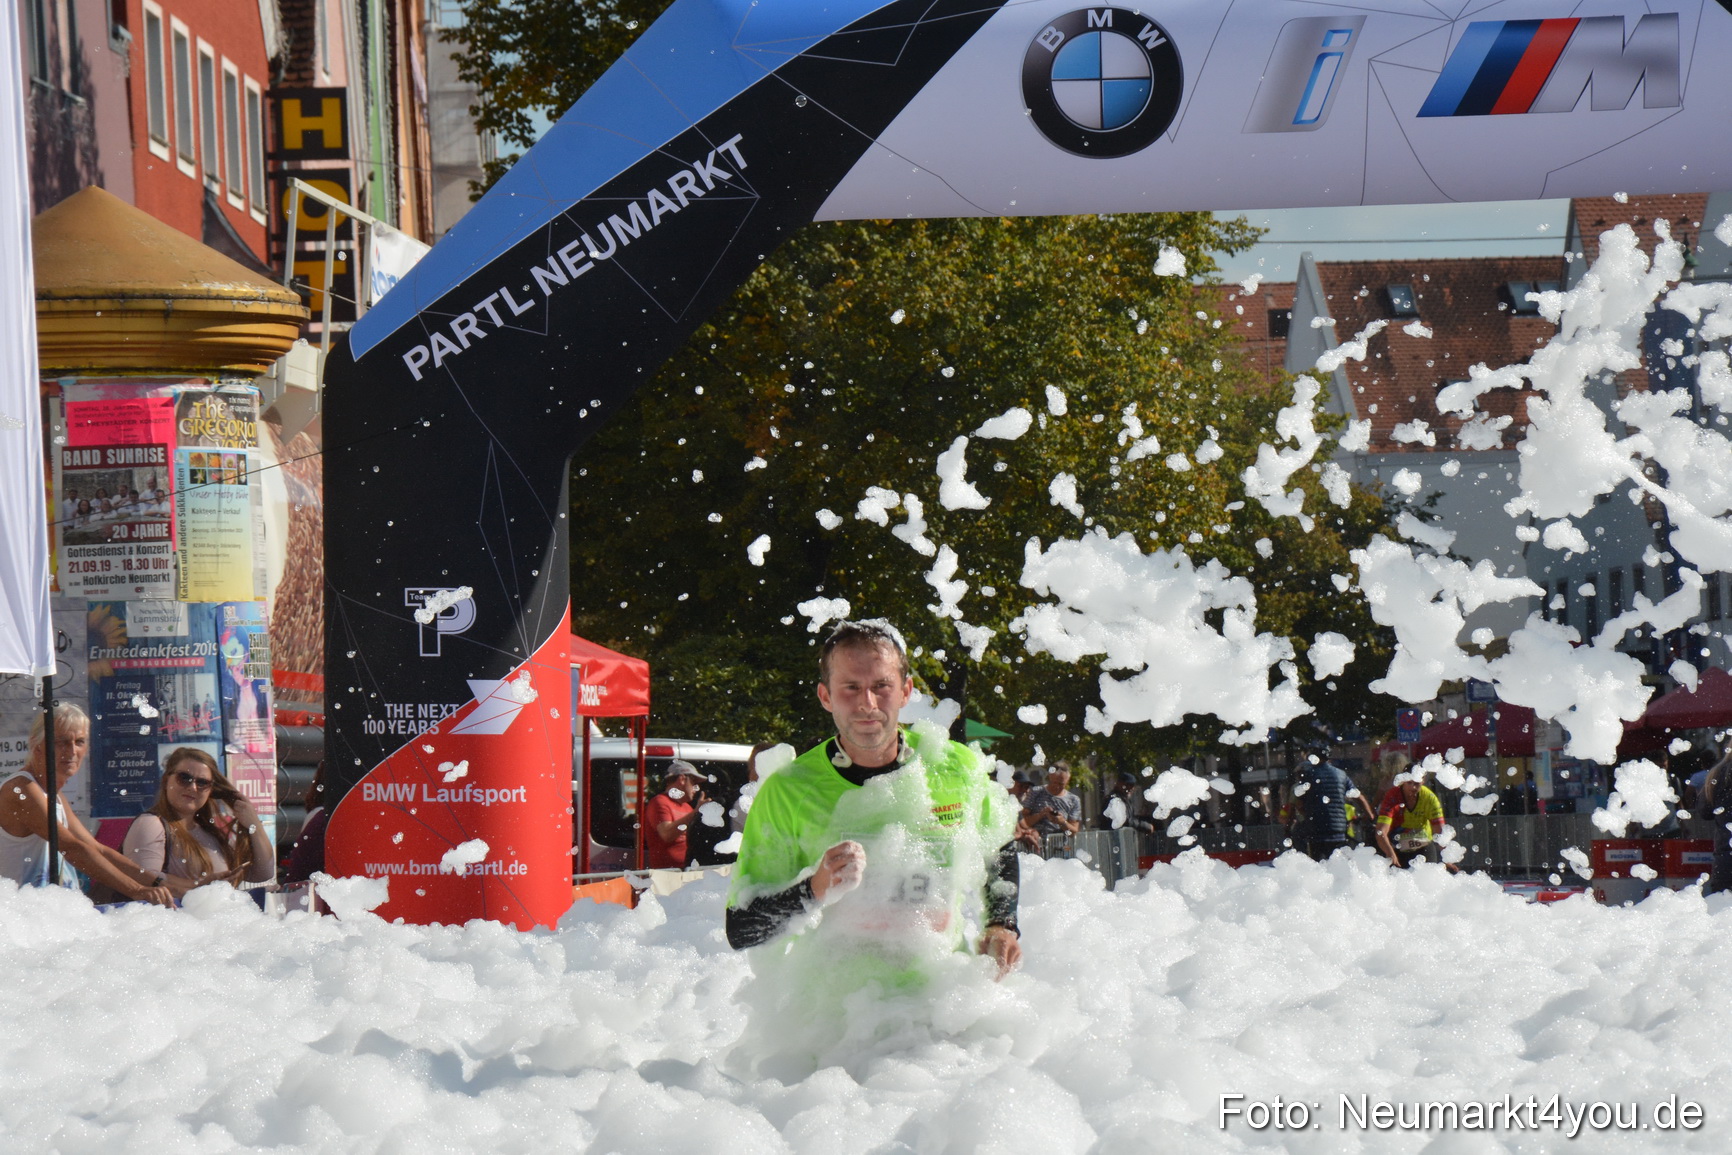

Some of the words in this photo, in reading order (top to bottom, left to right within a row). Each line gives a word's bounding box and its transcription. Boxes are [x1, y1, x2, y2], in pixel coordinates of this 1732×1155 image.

[1036, 9, 1167, 53] BMW
[402, 284, 536, 382] PARTL
[529, 133, 748, 297] NEUMARKT
[63, 449, 102, 466] BAND
[106, 447, 165, 464] SUNRISE
[112, 525, 128, 539] 20
[132, 523, 169, 538] JAHRE
[177, 519, 187, 547] andere
[67, 546, 126, 558] Gottesdienst
[136, 544, 169, 555] Konzert
[178, 549, 187, 564] und
[68, 560, 111, 574] 21.09.19
[122, 558, 149, 571] 18.30
[152, 557, 169, 569] Uhr
[83, 574, 126, 586] Hofkirche
[129, 572, 170, 584] Neumarkt
[180, 566, 188, 599] Kakteen
[89, 643, 190, 660] Erntedankfest
[192, 642, 218, 657] 2019
[116, 681, 141, 690] Freitag
[384, 703, 415, 718] THE
[418, 703, 459, 718] NEXT
[362, 719, 386, 735] 100
[388, 719, 440, 735] YEARS
[115, 749, 146, 758] Samstag
[107, 760, 117, 768] 12.
[120, 759, 154, 768] Oktober
[118, 769, 128, 777] 20
[129, 769, 145, 777] Uhr
[363, 783, 416, 801] BMW
[422, 783, 527, 806] Laufsport
[365, 859, 528, 878] www.bmwpartl.de
